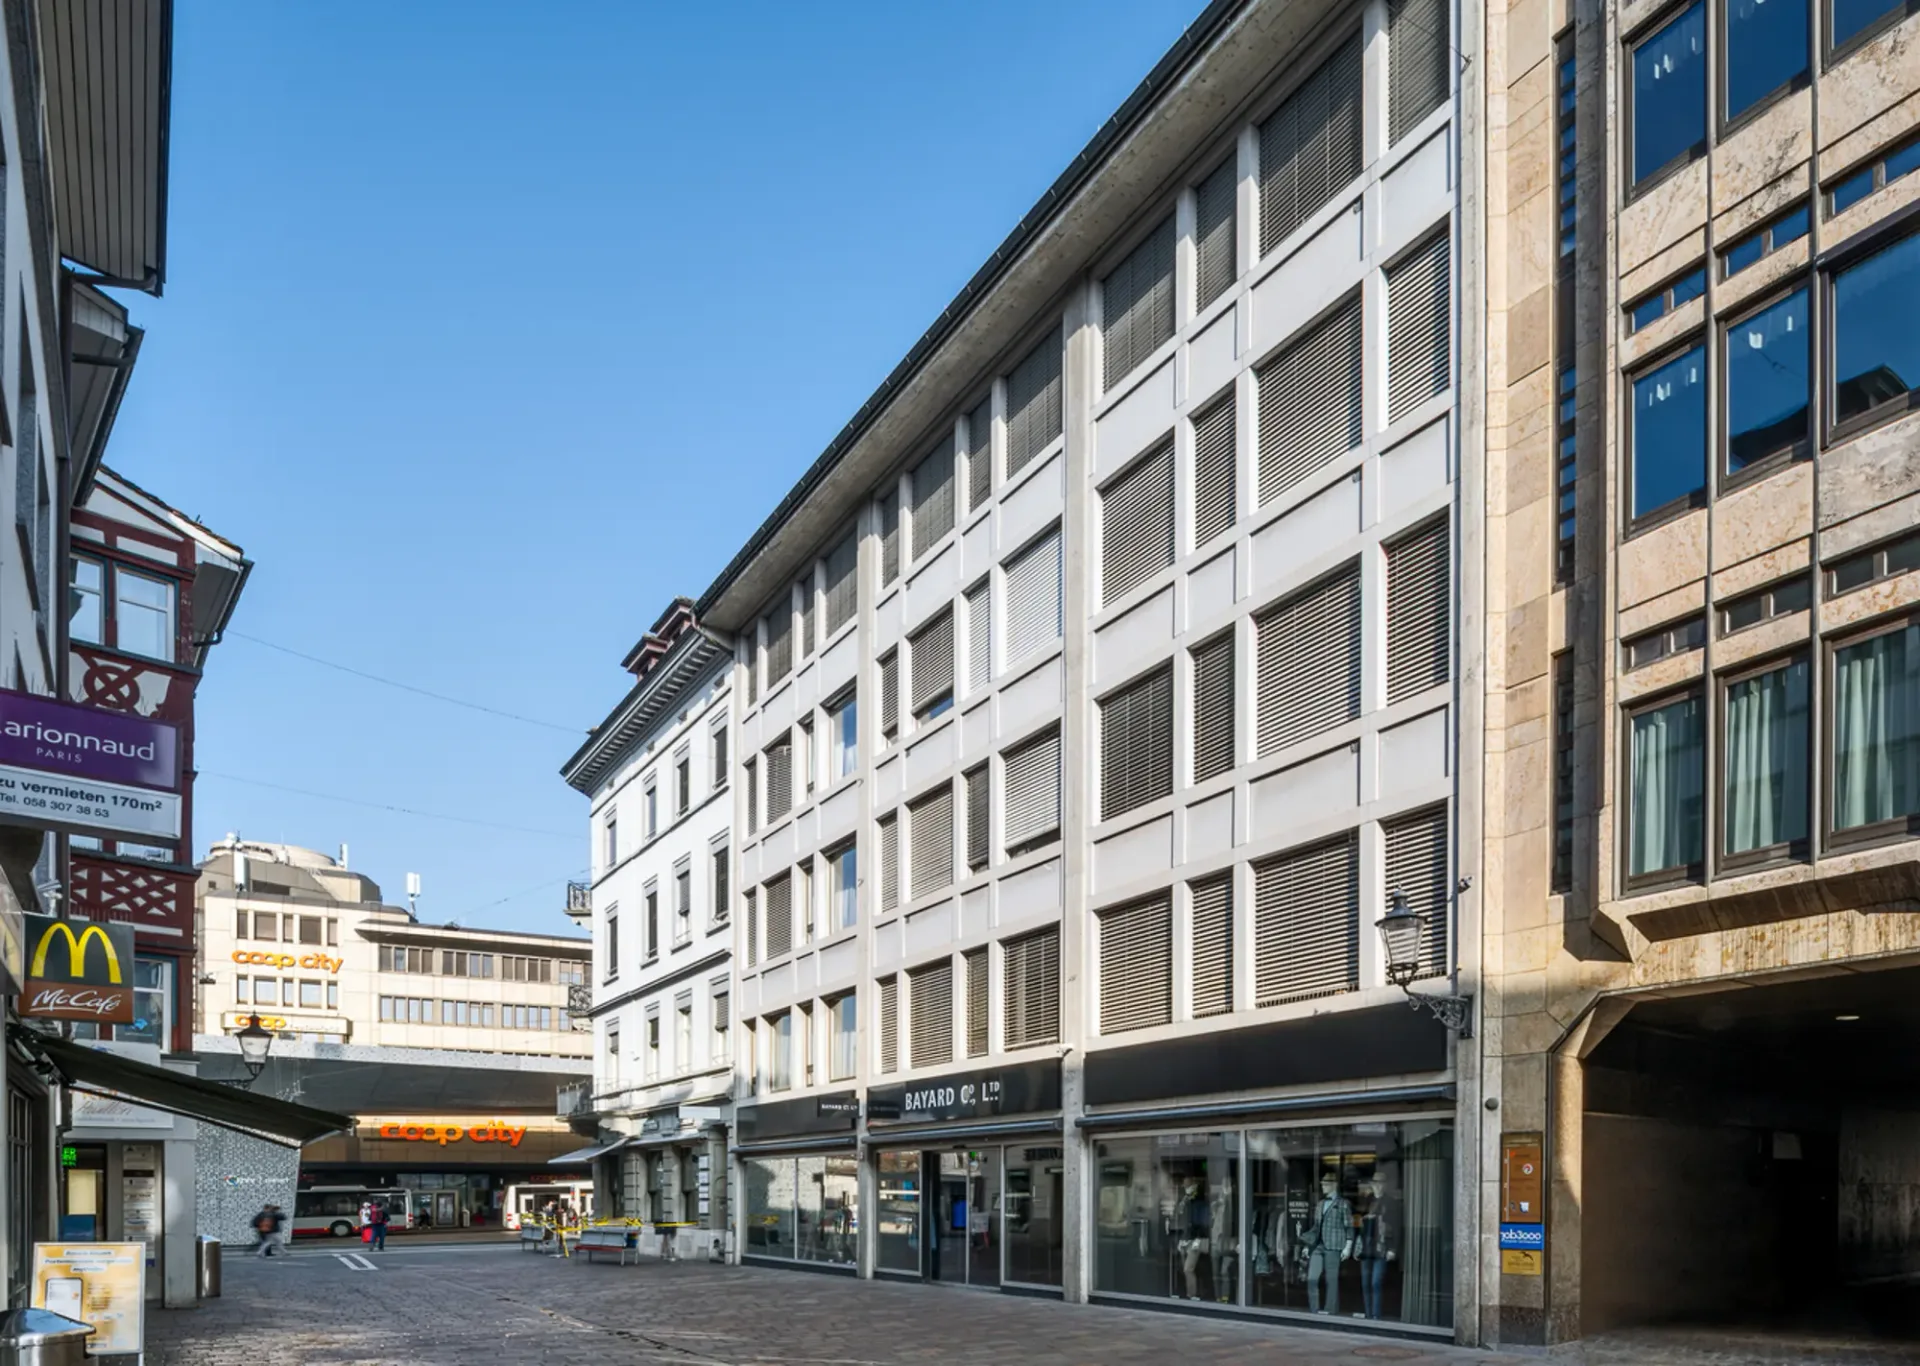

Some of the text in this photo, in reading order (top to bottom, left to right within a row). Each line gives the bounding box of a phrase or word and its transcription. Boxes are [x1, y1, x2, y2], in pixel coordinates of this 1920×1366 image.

[0, 721, 155, 761] arionnaud
[36, 747, 82, 763] PARIS
[21, 782, 105, 804] vermieten
[23, 796, 46, 808] 058
[50, 801, 72, 812] 307
[76, 804, 91, 816] 38
[94, 808, 110, 818] 53
[231, 950, 344, 974] coop city
[234, 1015, 287, 1031] cop
[905, 1087, 955, 1111] BAYARD
[380, 1120, 527, 1146] coop city
